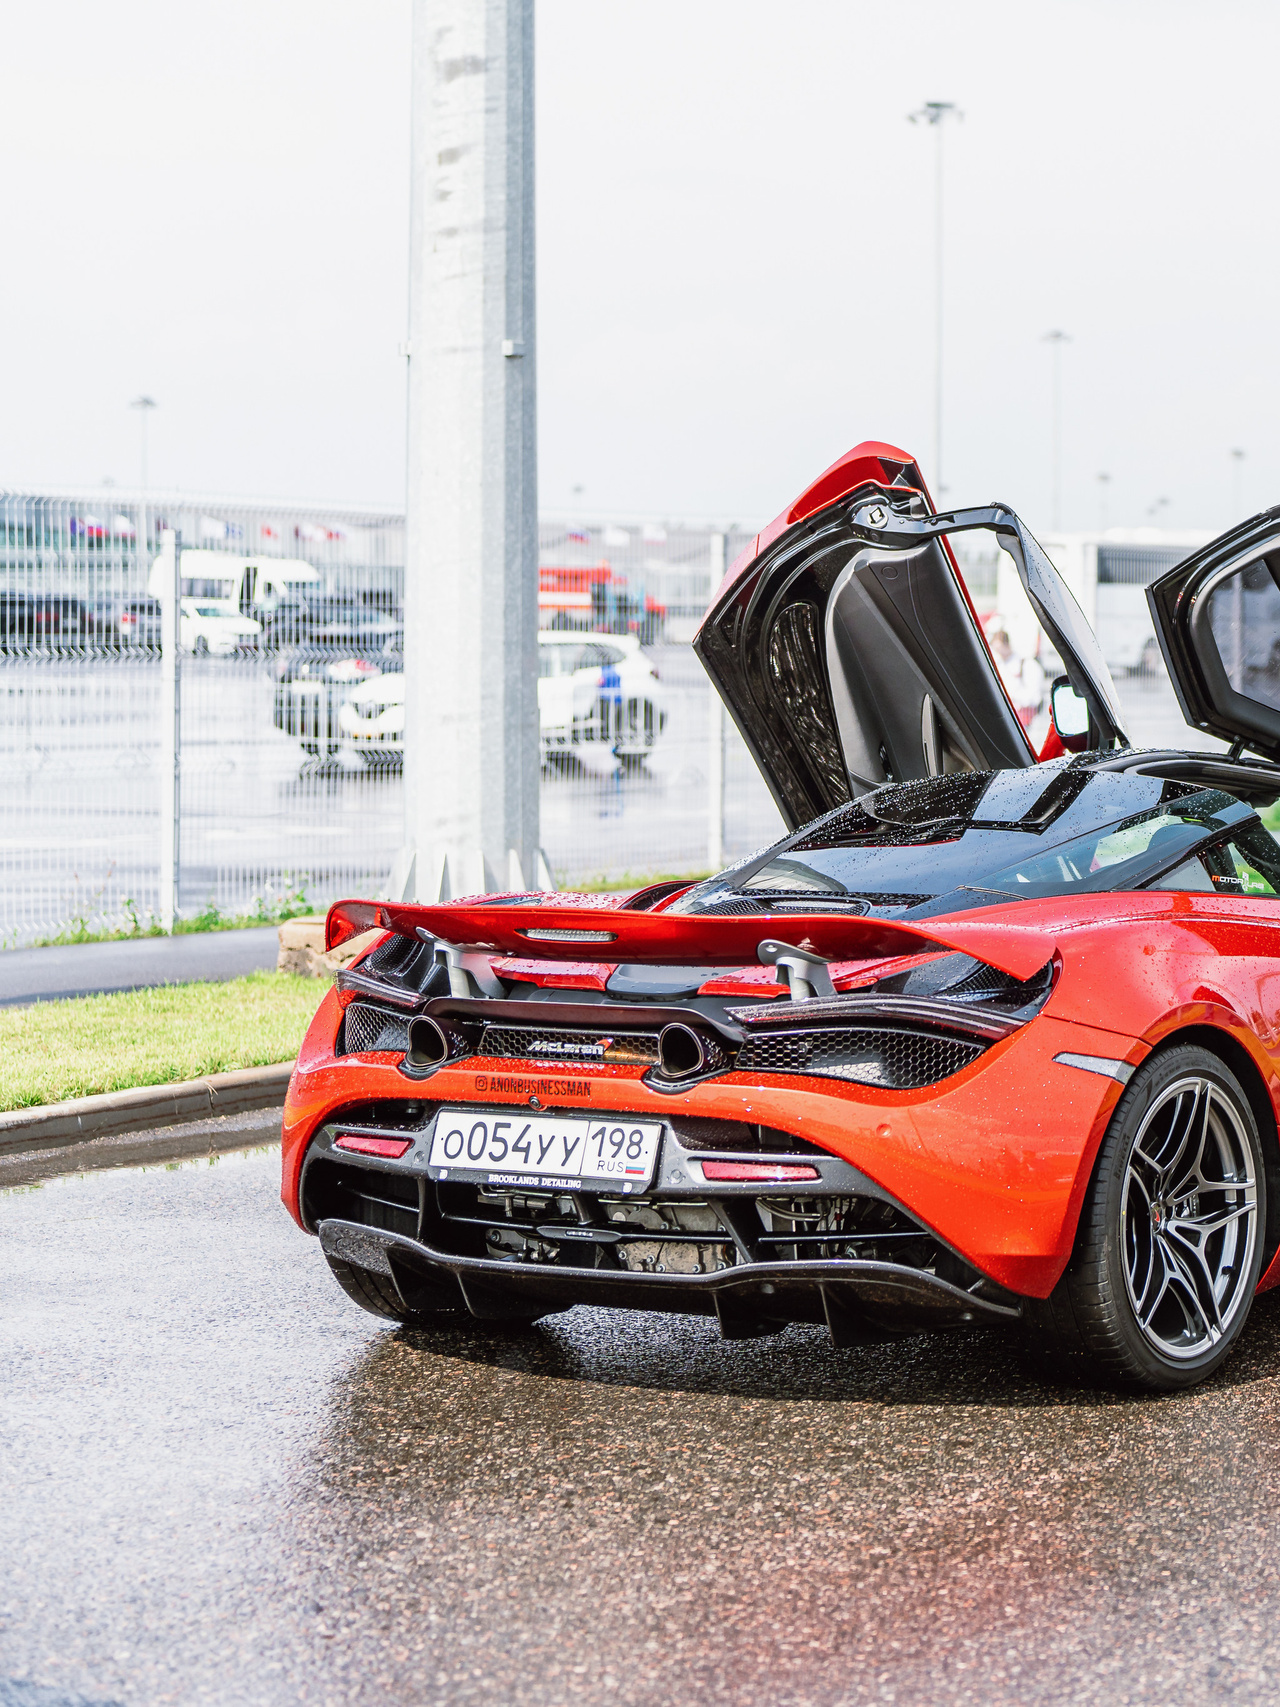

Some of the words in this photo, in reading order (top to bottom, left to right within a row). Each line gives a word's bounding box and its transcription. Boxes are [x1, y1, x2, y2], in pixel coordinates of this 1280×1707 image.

[527, 1041, 604, 1056] McLaren
[490, 1077, 591, 1096] ANONBUSINESSMAN
[591, 1126, 644, 1160] 198
[597, 1161, 624, 1173] RUS
[488, 1173, 539, 1186] BROOKLANDS
[541, 1177, 582, 1189] DETAILING
